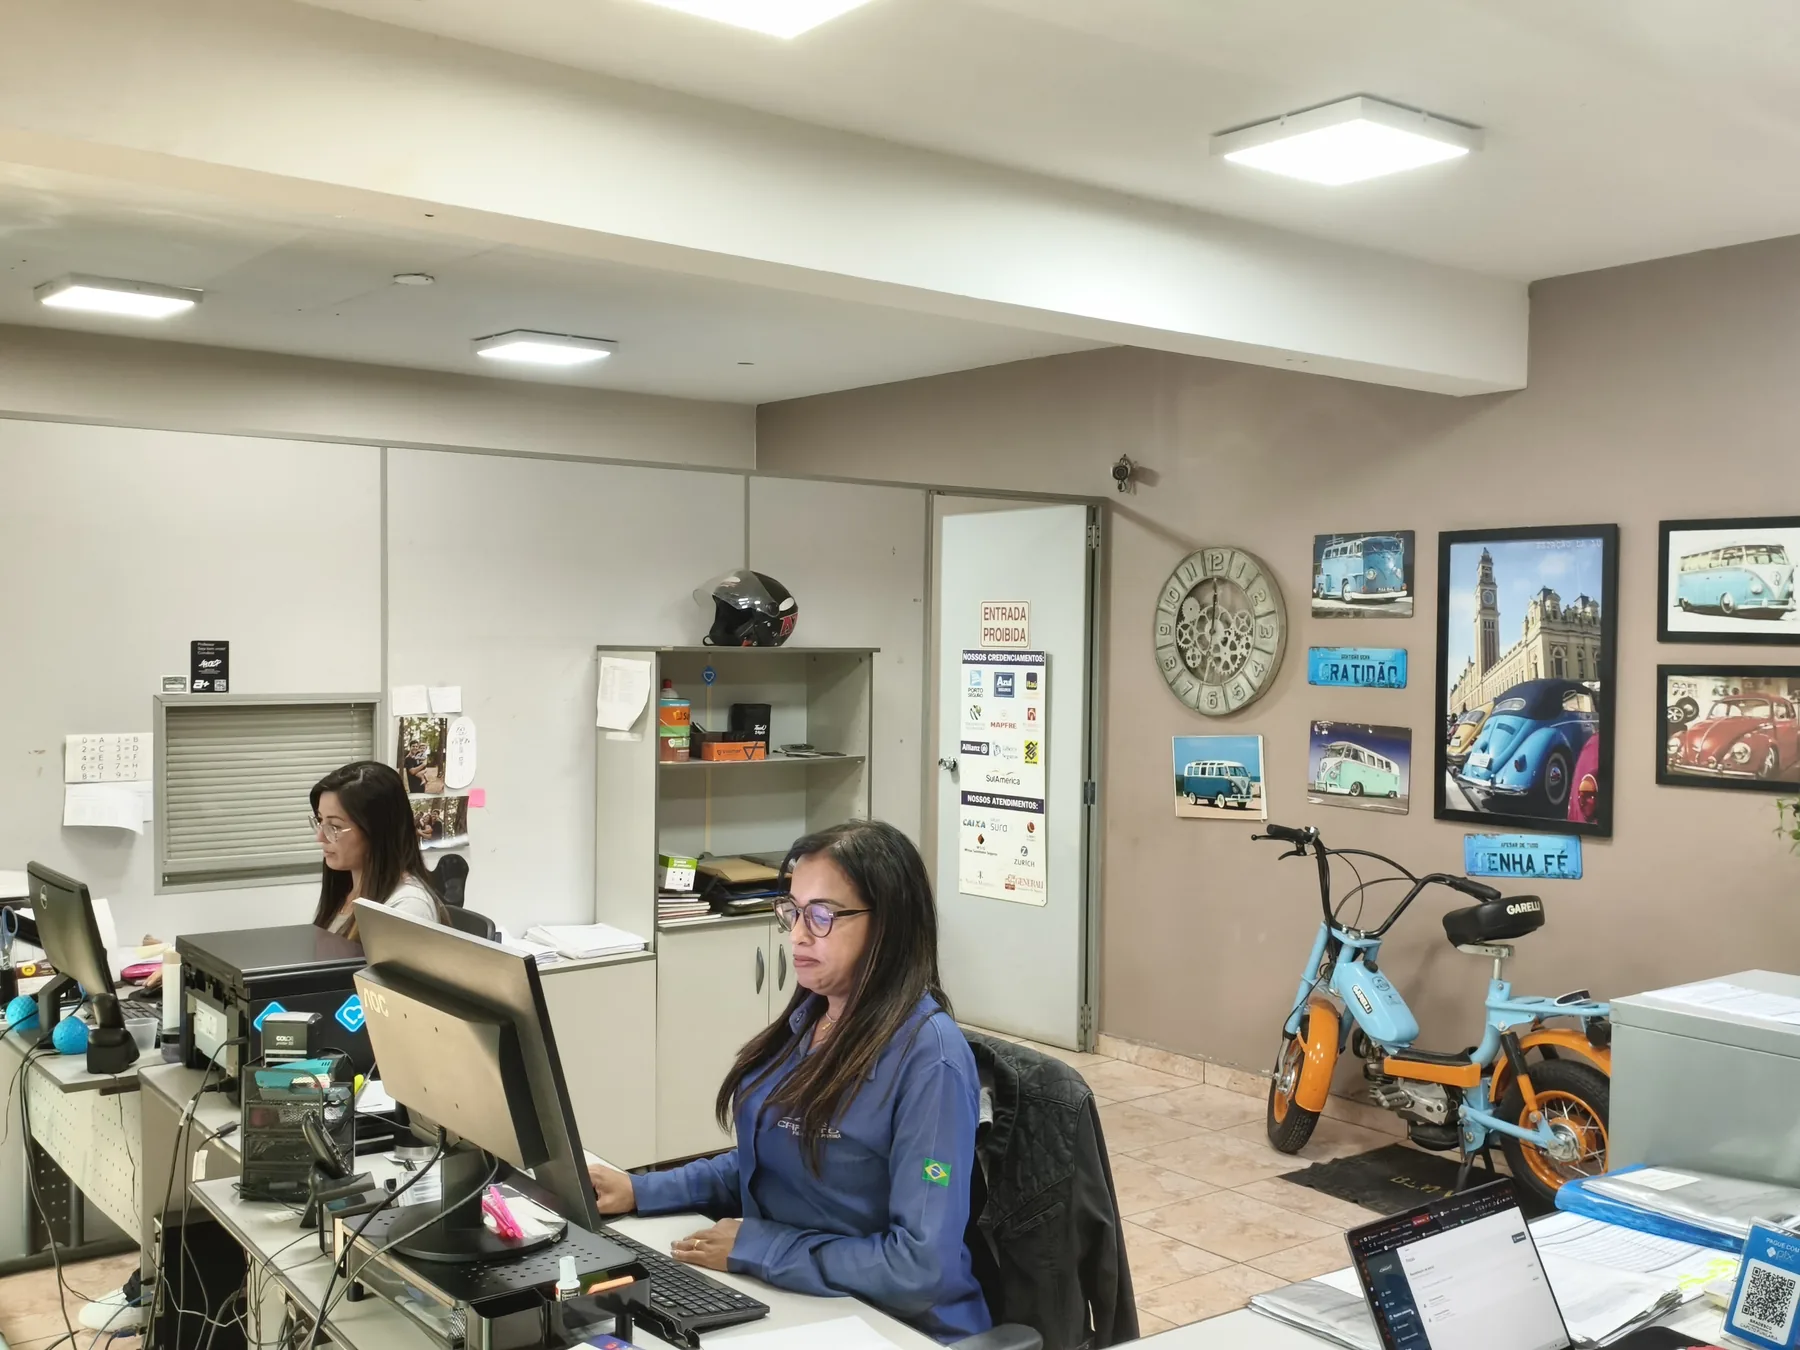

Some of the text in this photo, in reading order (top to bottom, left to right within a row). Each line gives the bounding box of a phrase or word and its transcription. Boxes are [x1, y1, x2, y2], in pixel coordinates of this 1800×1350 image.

[1211, 553, 1224, 571] 12
[1253, 590, 1266, 606] 2
[984, 607, 1026, 621] ENTRADA
[983, 628, 1026, 642] PROIBIDA
[1259, 625, 1273, 638] 3
[1253, 660, 1264, 677] 4
[1207, 692, 1218, 708] 6
[962, 743, 980, 752] Allianz
[968, 795, 1038, 809] NOSSOS ATENDIMENTOS:
[963, 819, 986, 828] CAIXA
[1014, 859, 1035, 867] ZURICH
[1544, 850, 1568, 873] FÉ
[1506, 901, 1540, 915] GARELLI
[1766, 1237, 1800, 1253] PAGUE COM
[1776, 1250, 1794, 1262] pix
[1750, 1319, 1772, 1330] BRADESCO
